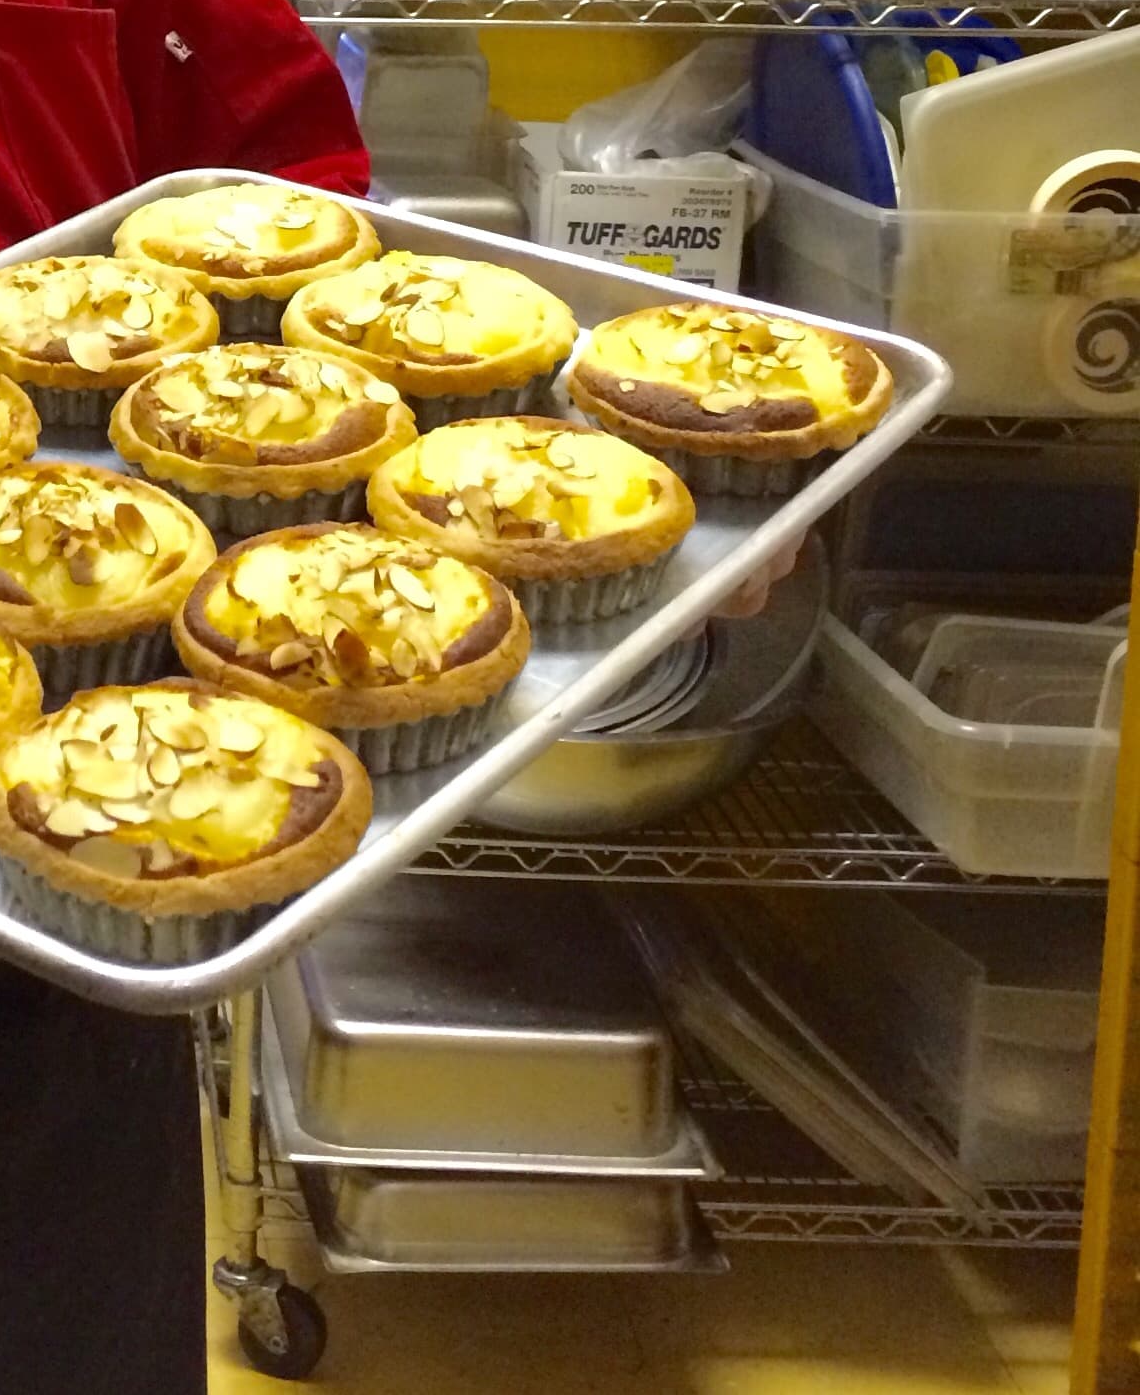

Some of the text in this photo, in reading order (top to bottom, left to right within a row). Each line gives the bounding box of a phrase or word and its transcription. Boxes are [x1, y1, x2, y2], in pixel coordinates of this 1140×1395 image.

[570, 183, 595, 196] 200
[567, 221, 722, 250] TUFF GARDS
